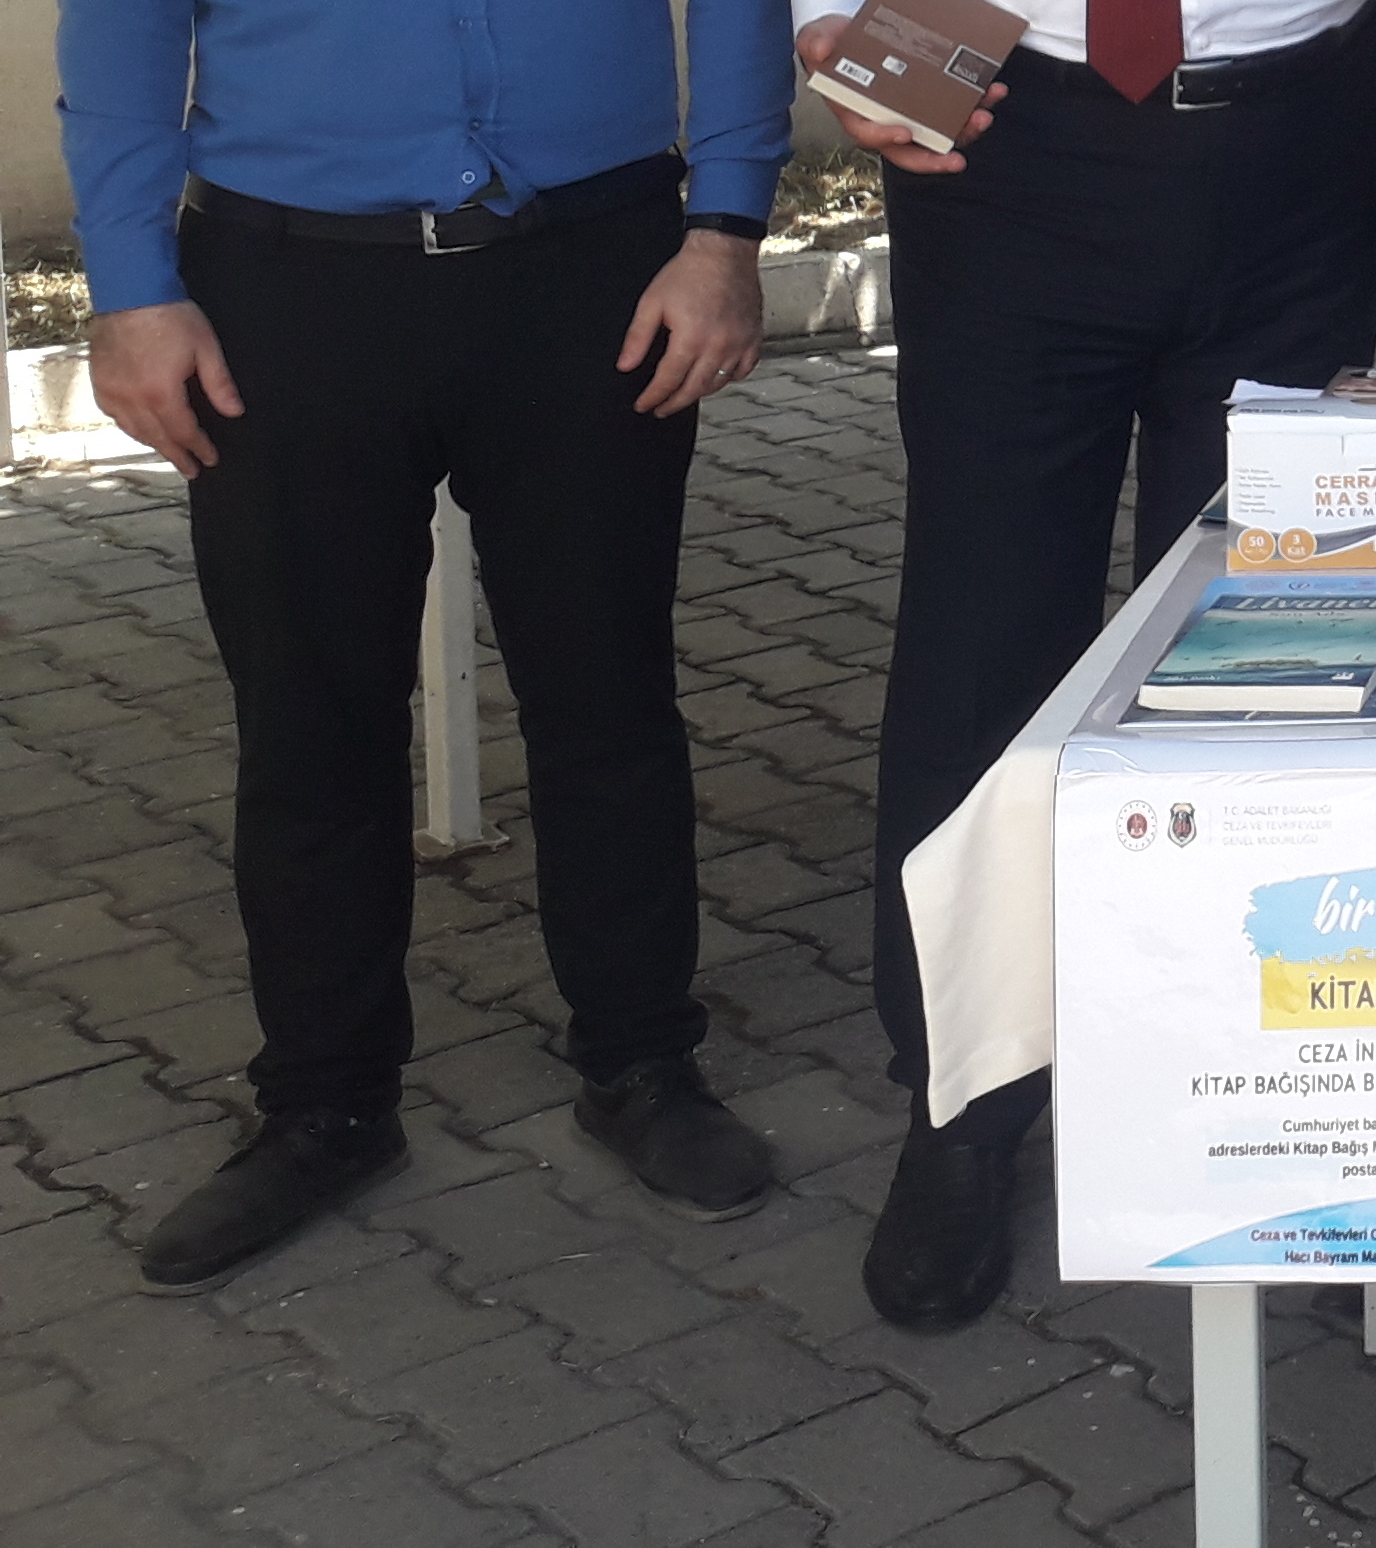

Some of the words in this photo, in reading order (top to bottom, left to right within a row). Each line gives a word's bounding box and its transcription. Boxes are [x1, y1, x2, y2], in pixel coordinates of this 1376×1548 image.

[1315, 507, 1357, 518] FACE
[1248, 536, 1265, 548] 50
[1291, 534, 1301, 544] 3
[1313, 881, 1375, 934] bir
[1298, 1043, 1348, 1064] CEZA
[1191, 1073, 1247, 1097] KİTAP
[1254, 1071, 1356, 1098] BAĞIŞINDA
[1282, 1118, 1360, 1135] Cumhuriyet
[1208, 1141, 1290, 1158] adreslerdeki
[1293, 1141, 1329, 1158] Kitap
[1331, 1140, 1369, 1157] Bağış
